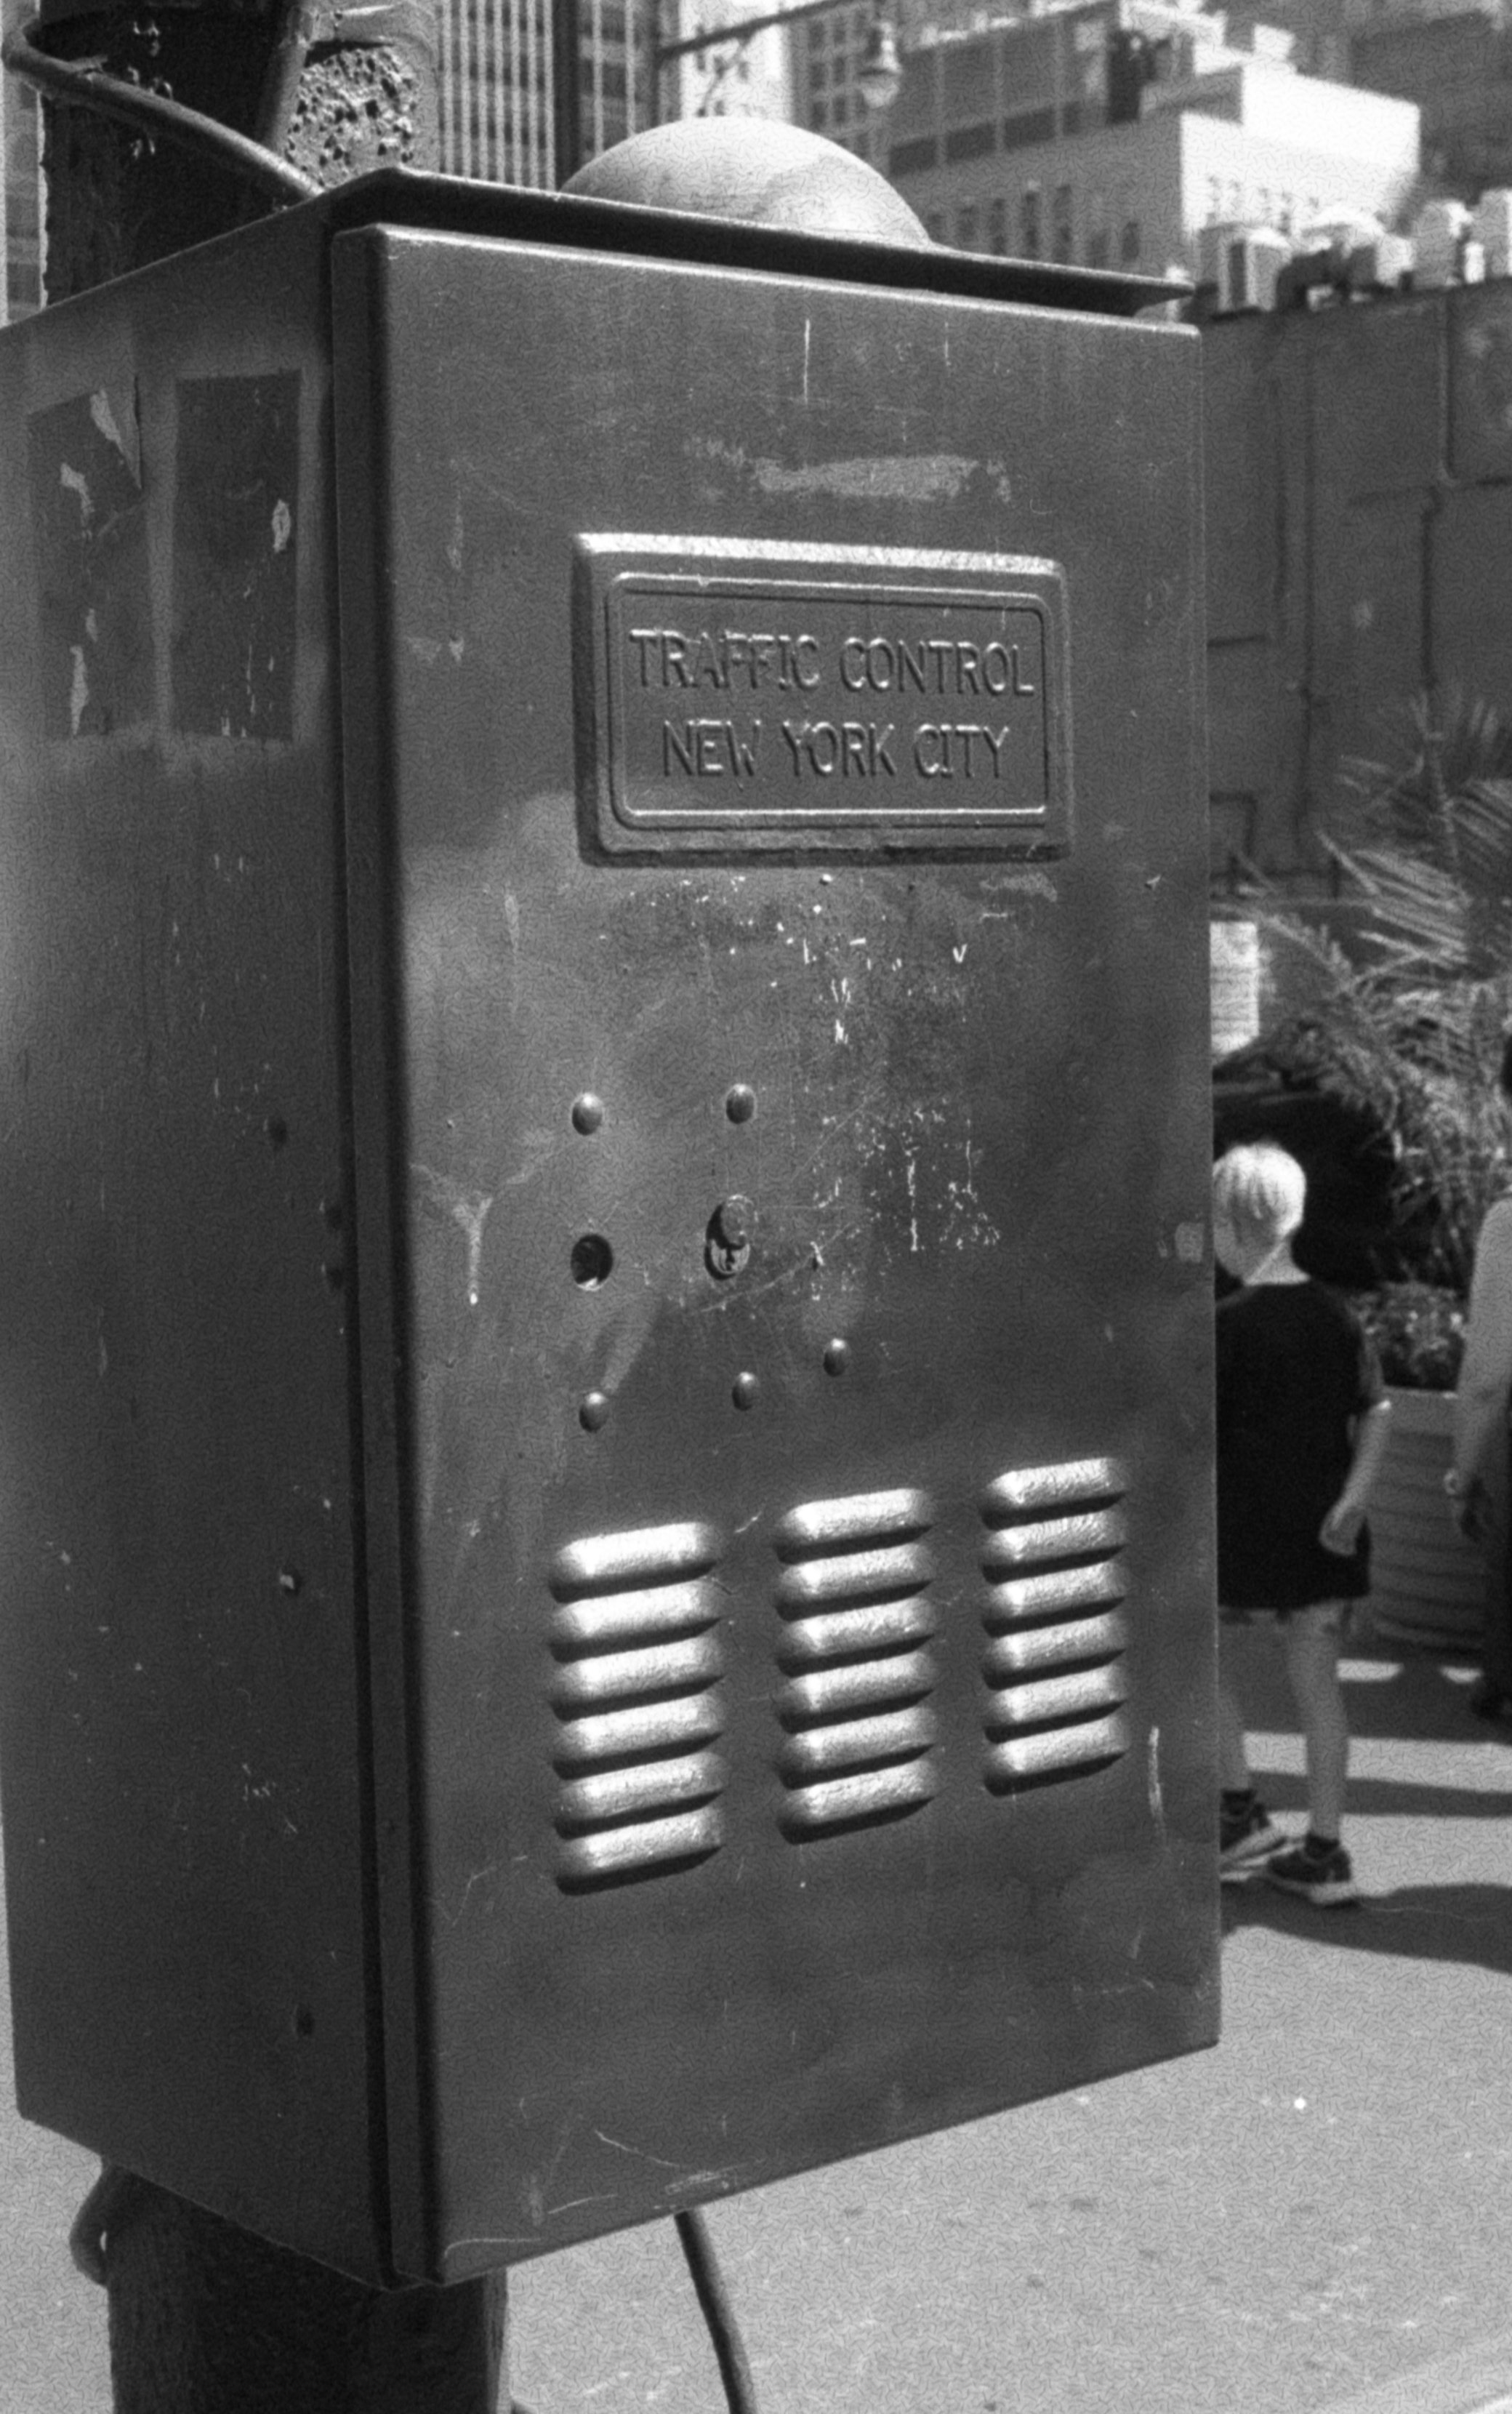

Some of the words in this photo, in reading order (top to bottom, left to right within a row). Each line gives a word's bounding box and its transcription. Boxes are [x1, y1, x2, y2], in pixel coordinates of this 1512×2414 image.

[628, 628, 820, 691] TRAFFIC
[839, 636, 1035, 696] CONTROL
[662, 718, 762, 777] NEW
[782, 721, 896, 778] YORK
[913, 723, 1010, 779] CITY
